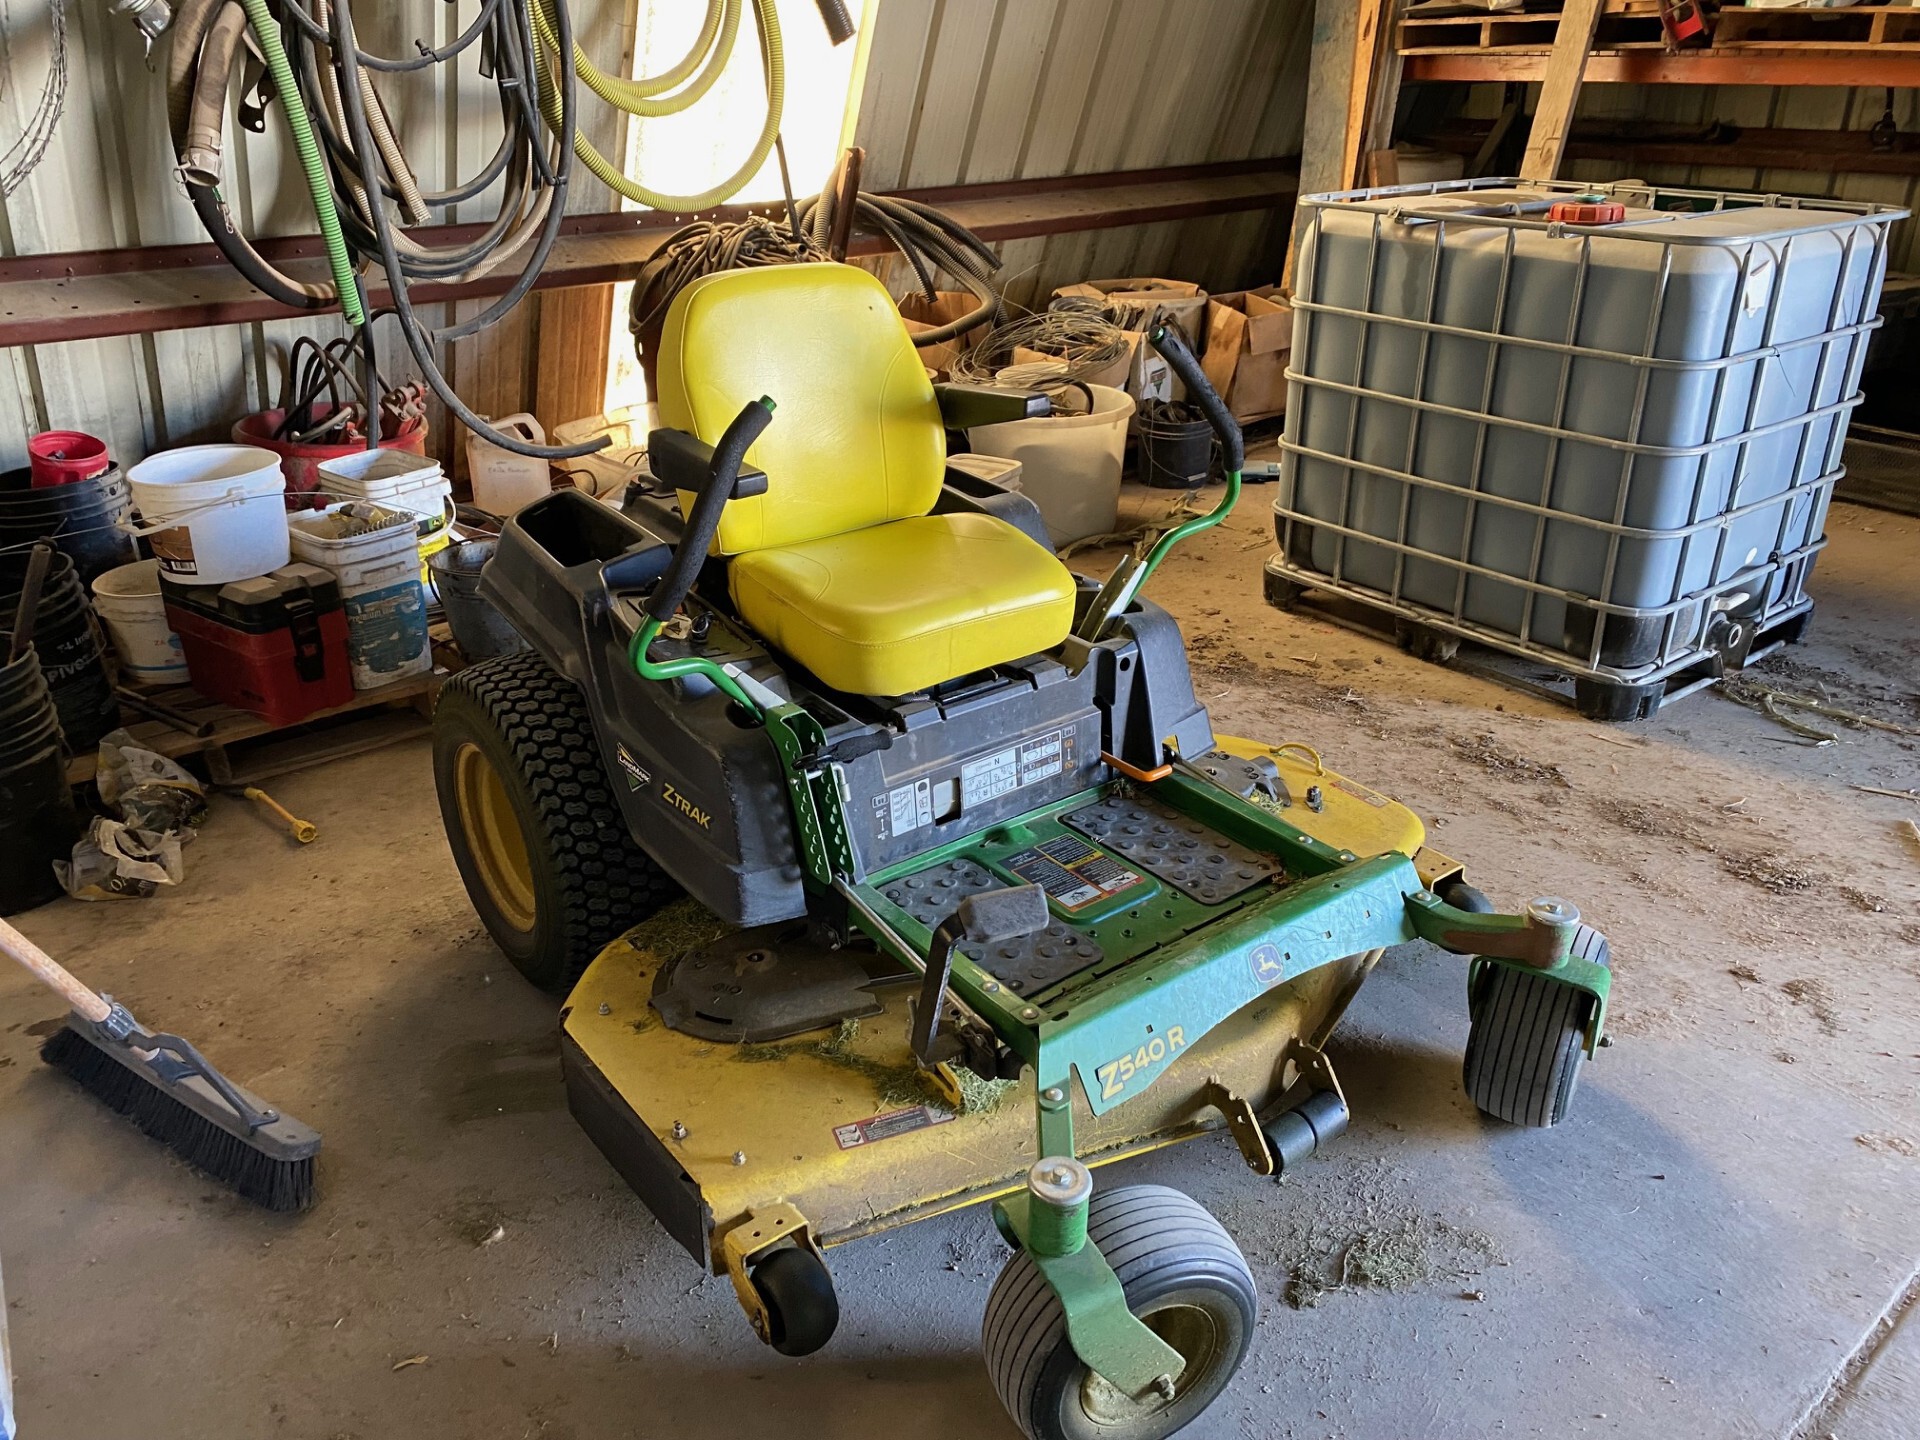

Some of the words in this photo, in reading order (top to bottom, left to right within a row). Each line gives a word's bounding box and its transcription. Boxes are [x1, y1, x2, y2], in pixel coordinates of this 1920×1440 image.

[662, 782, 711, 830] ZTRAK
[1098, 1043, 1167, 1102] Z540
[1166, 1025, 1188, 1052] R
